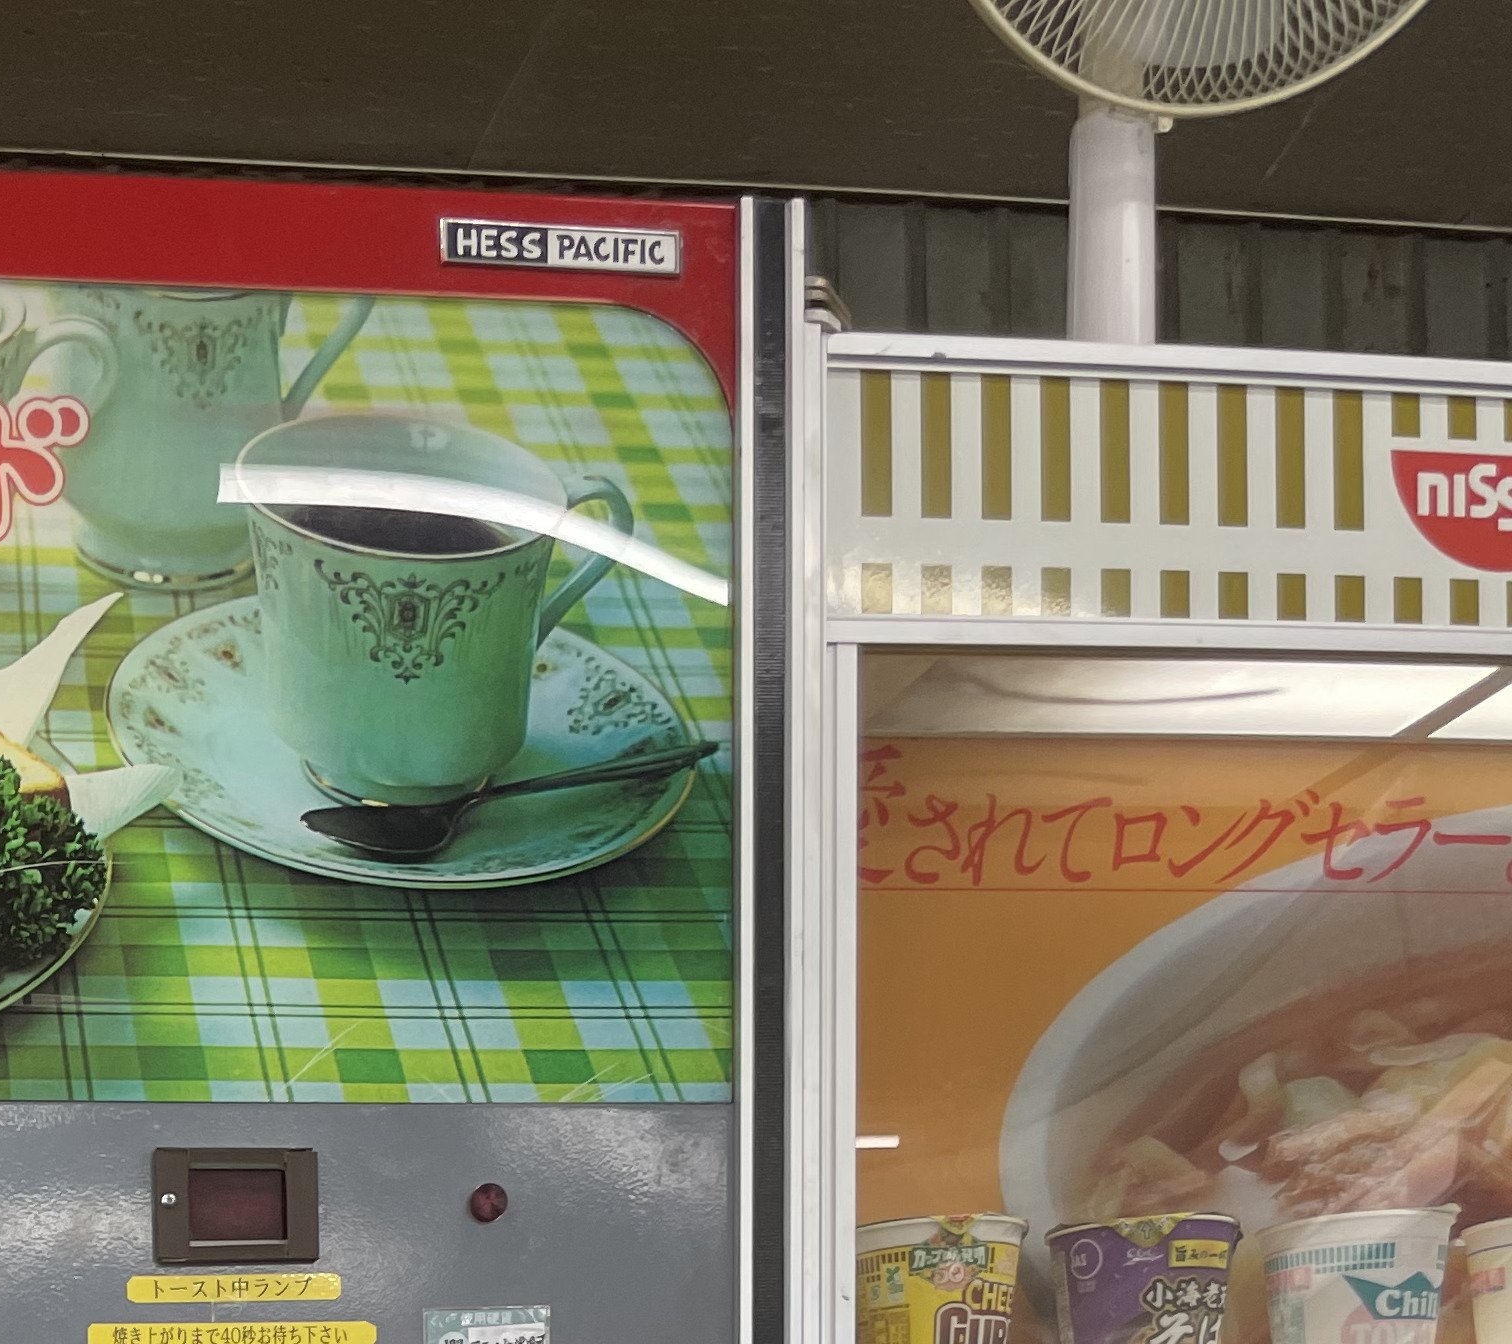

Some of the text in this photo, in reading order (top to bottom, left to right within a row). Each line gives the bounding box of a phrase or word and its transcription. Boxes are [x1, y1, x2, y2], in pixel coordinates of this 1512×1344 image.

[456, 227, 665, 266] HESS PACIFIC
[859, 744, 1512, 888] されてロングセラー
[151, 1276, 313, 1299] トースト中ランプ
